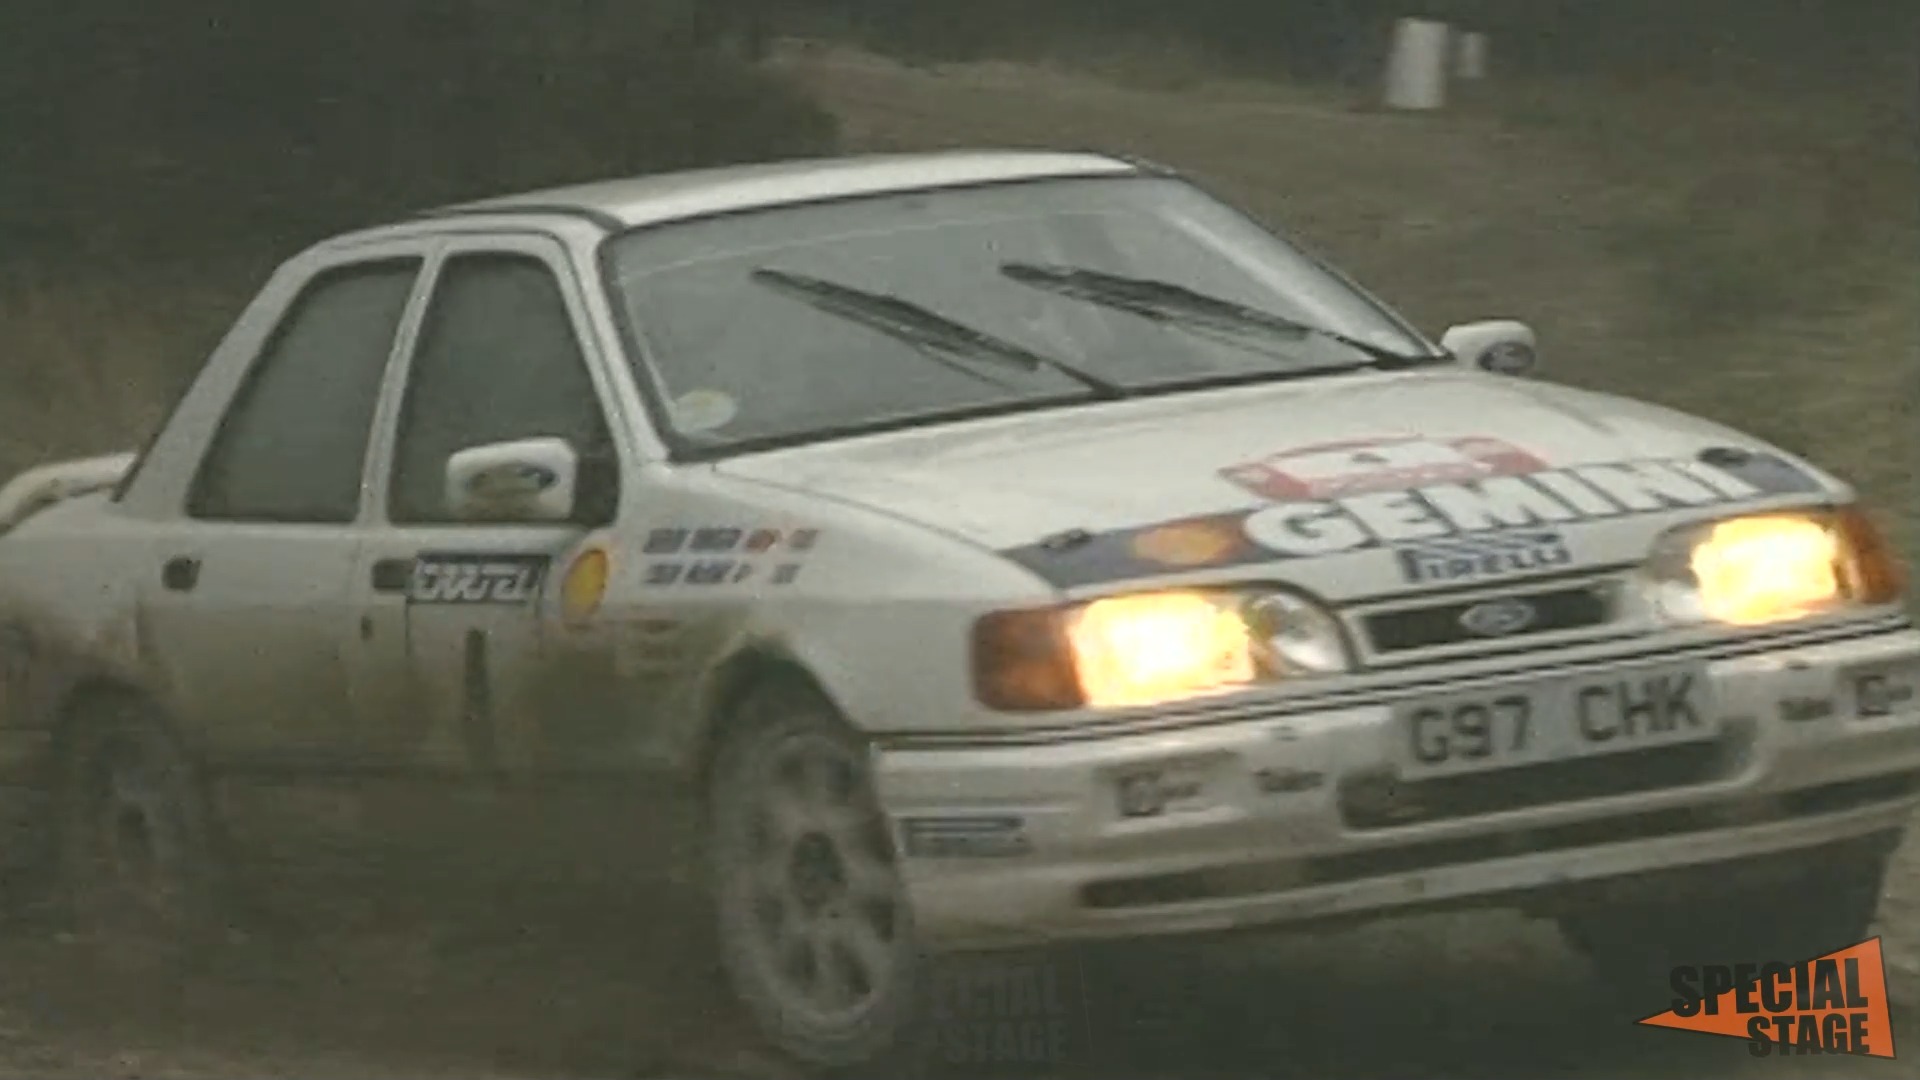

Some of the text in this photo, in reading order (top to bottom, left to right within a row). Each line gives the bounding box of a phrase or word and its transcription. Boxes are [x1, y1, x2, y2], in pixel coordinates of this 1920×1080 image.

[1243, 461, 1762, 553] GEMINI
[1398, 533, 1571, 582] PIRELLI
[1411, 695, 1532, 763] G97
[1578, 672, 1700, 740] CHK
